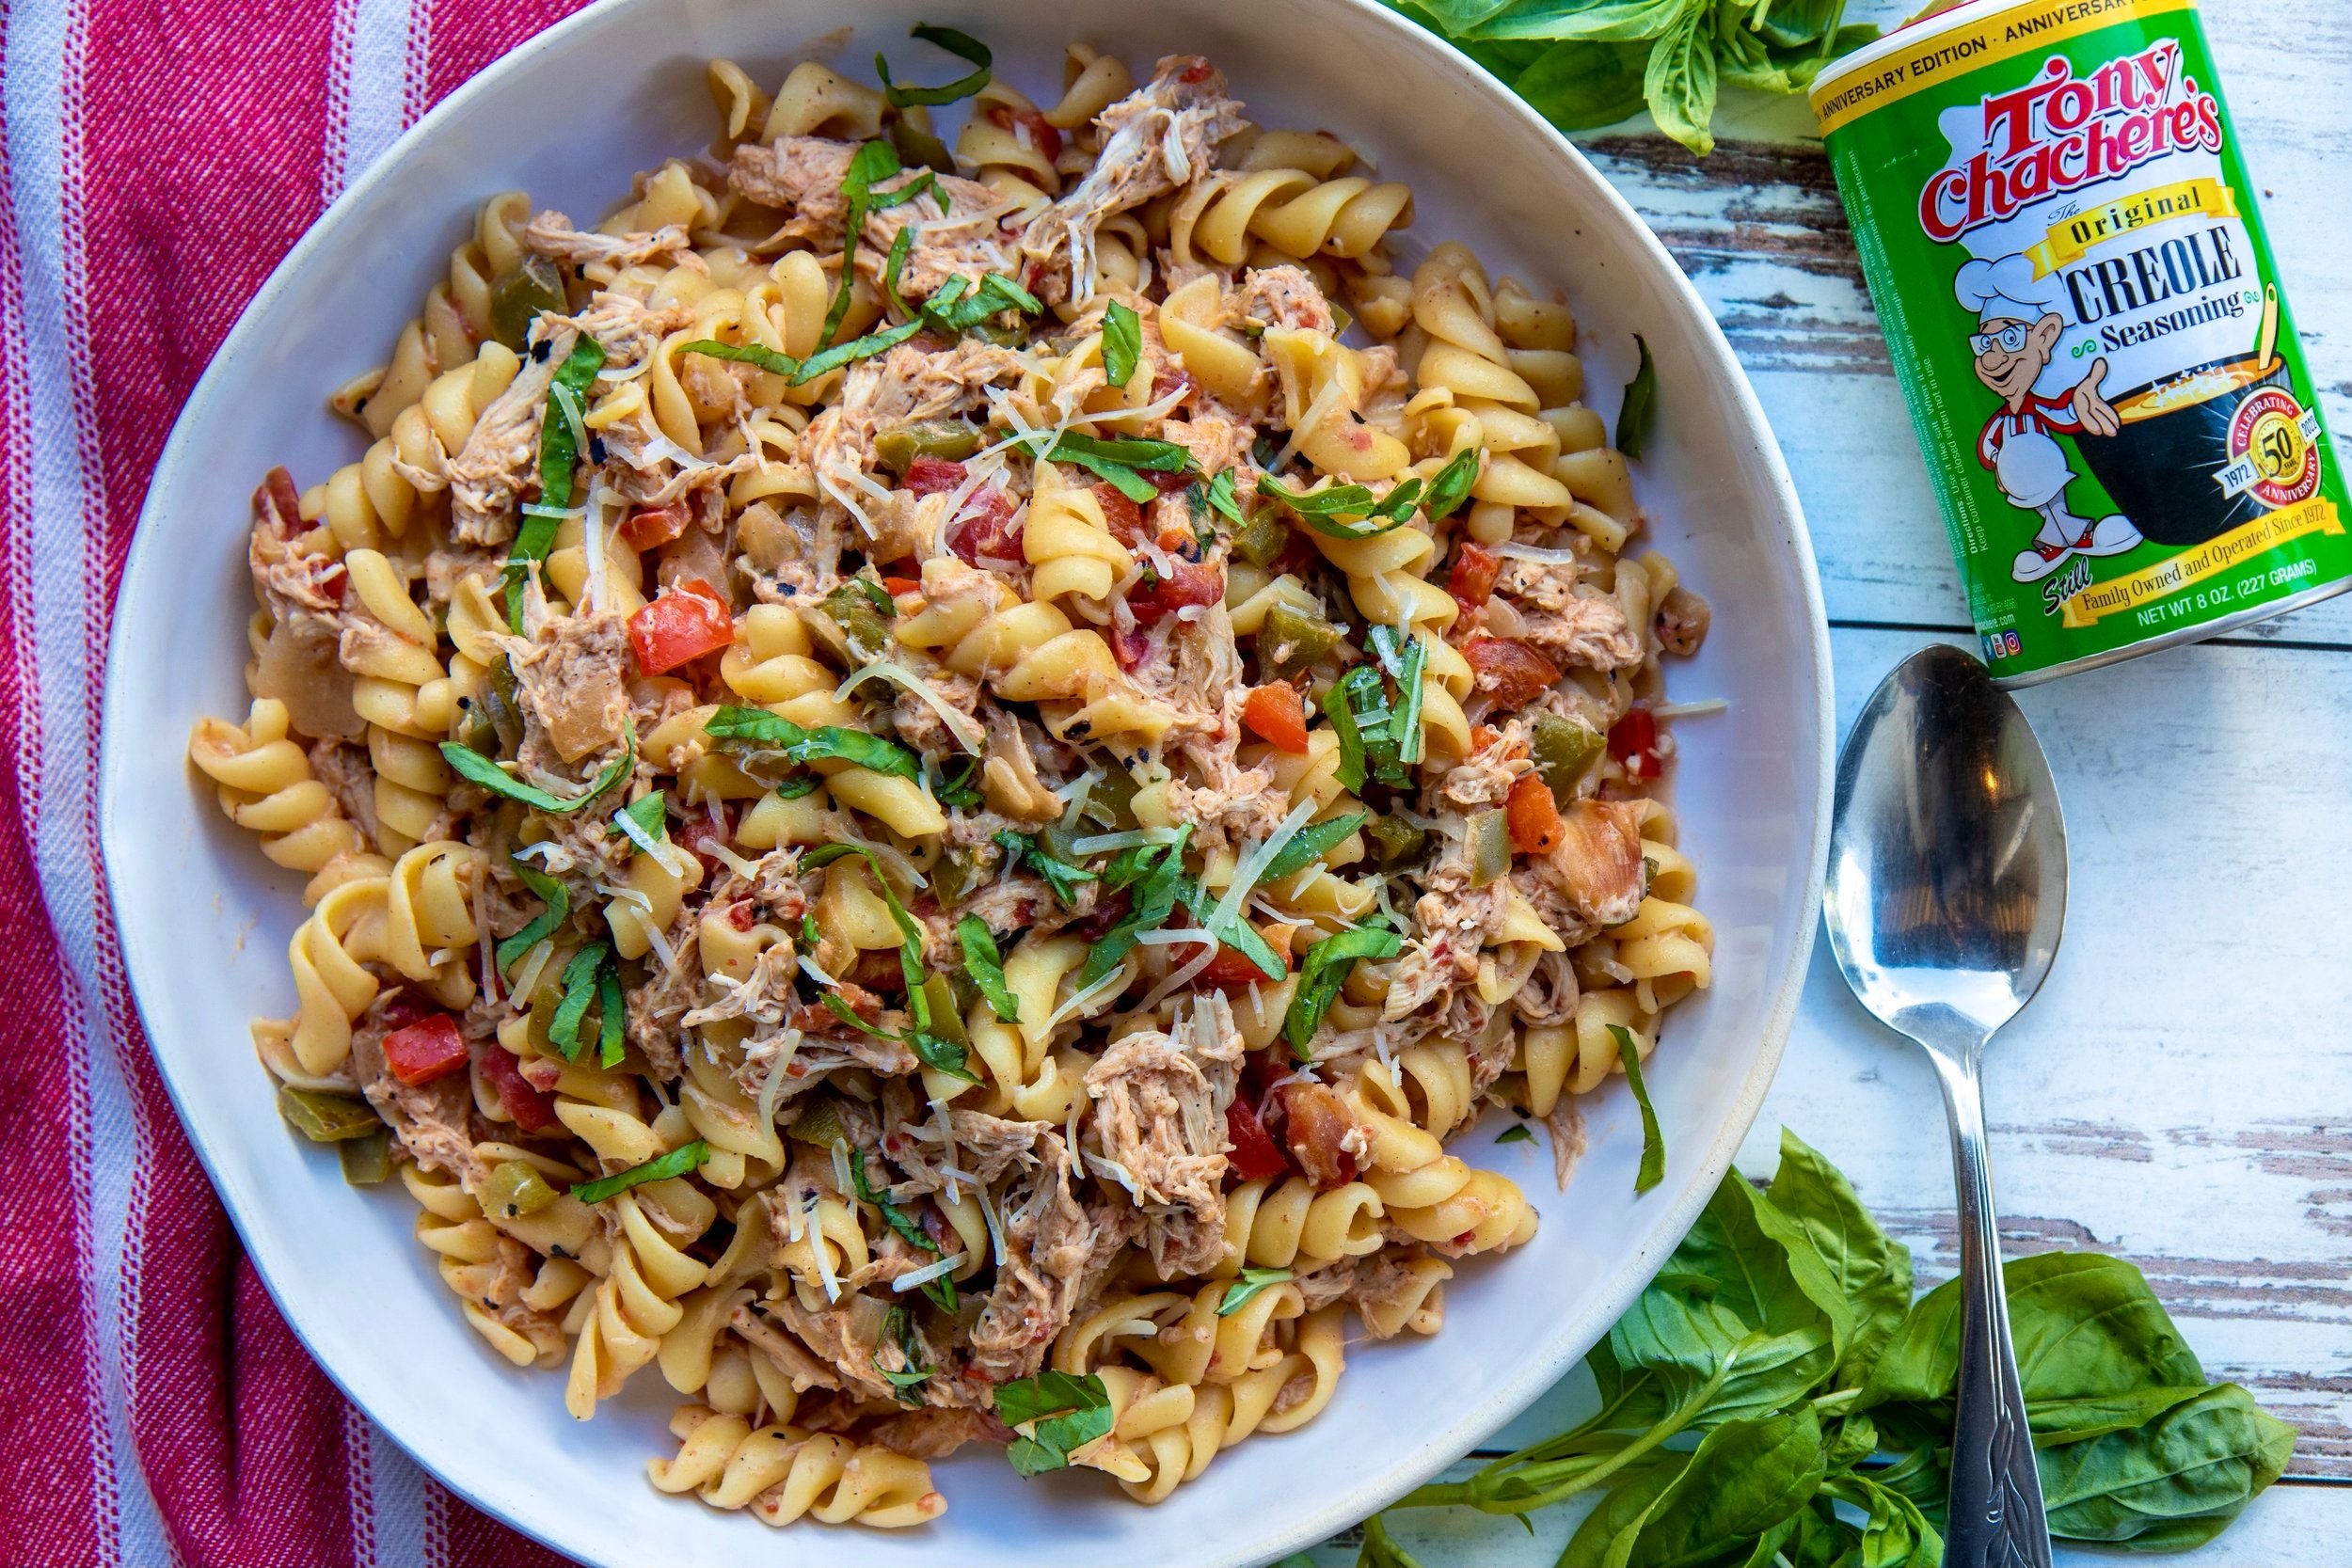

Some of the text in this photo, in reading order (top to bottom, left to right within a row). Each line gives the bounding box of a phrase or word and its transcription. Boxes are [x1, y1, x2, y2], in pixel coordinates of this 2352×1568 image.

[1822, 66, 1904, 120] ANNIVERSARY
[1911, 35, 1988, 77] EDITION
[1983, 42, 2176, 164] Tony
[1920, 77, 2221, 238] Chachere's
[1862, 204, 1872, 215] to
[2047, 198, 2081, 226] The
[2071, 186, 2201, 245] Original
[1867, 218, 1888, 267] seasoned
[2066, 225, 2243, 325] CREOLE
[1902, 332, 1918, 358] salty
[2100, 291, 2245, 354] Seasoning
[1918, 384, 1934, 415] When
[2237, 396, 2294, 447] CELEBRATING
[1937, 441, 1949, 460] like
[2301, 416, 2317, 437] 2022
[1920, 354, 1990, 551] Keep container closed when not in use.
[2224, 464, 2251, 488] 1972
[2263, 427, 2293, 478] 50
[2263, 453, 2316, 501] ANNIVERSARY
[1947, 473, 1960, 494] Use
[1954, 497, 1979, 554] Directions:
[2082, 503, 2327, 610] Family Owned and Operated Since 1972
[2042, 556, 2092, 615] Still
[2137, 558, 2317, 627] NET WT 8 OZ. (227 GRAMS)
